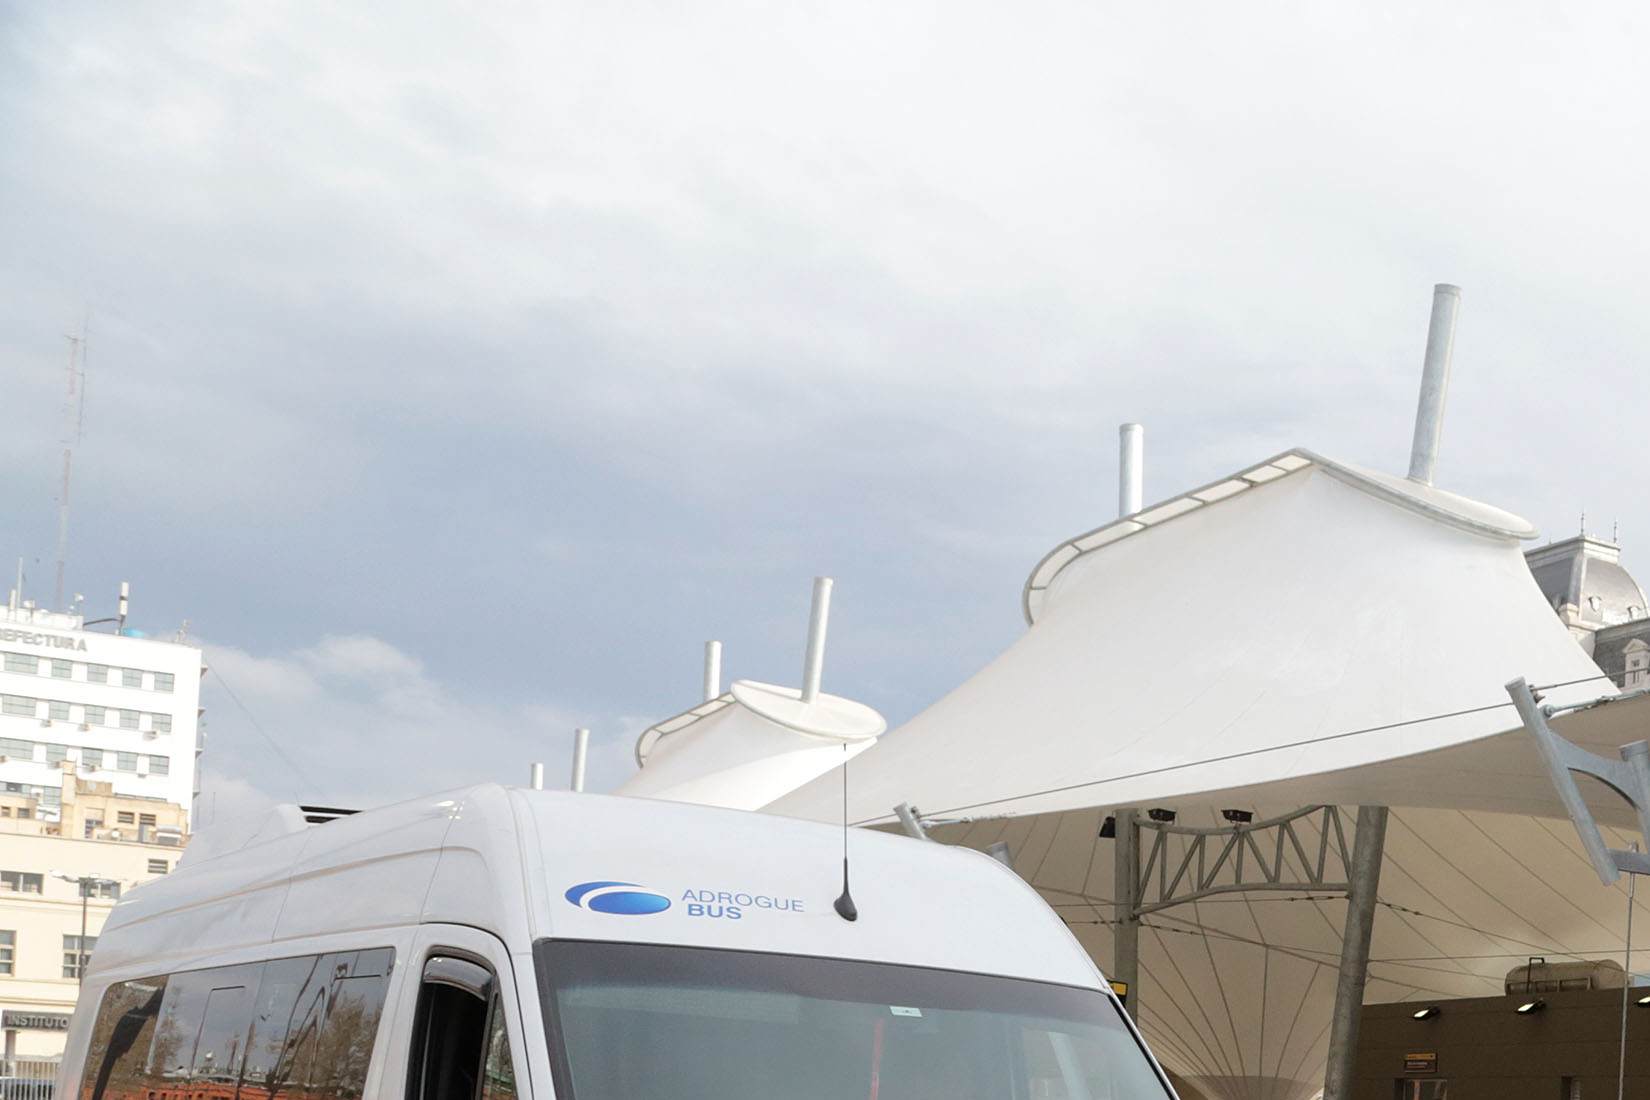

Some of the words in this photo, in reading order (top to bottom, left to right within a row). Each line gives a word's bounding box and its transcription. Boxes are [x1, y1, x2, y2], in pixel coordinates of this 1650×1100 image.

[682, 889, 805, 913] ADROGUE
[688, 903, 742, 919] BUS
[7, 1014, 69, 1028] INSTITUTO
